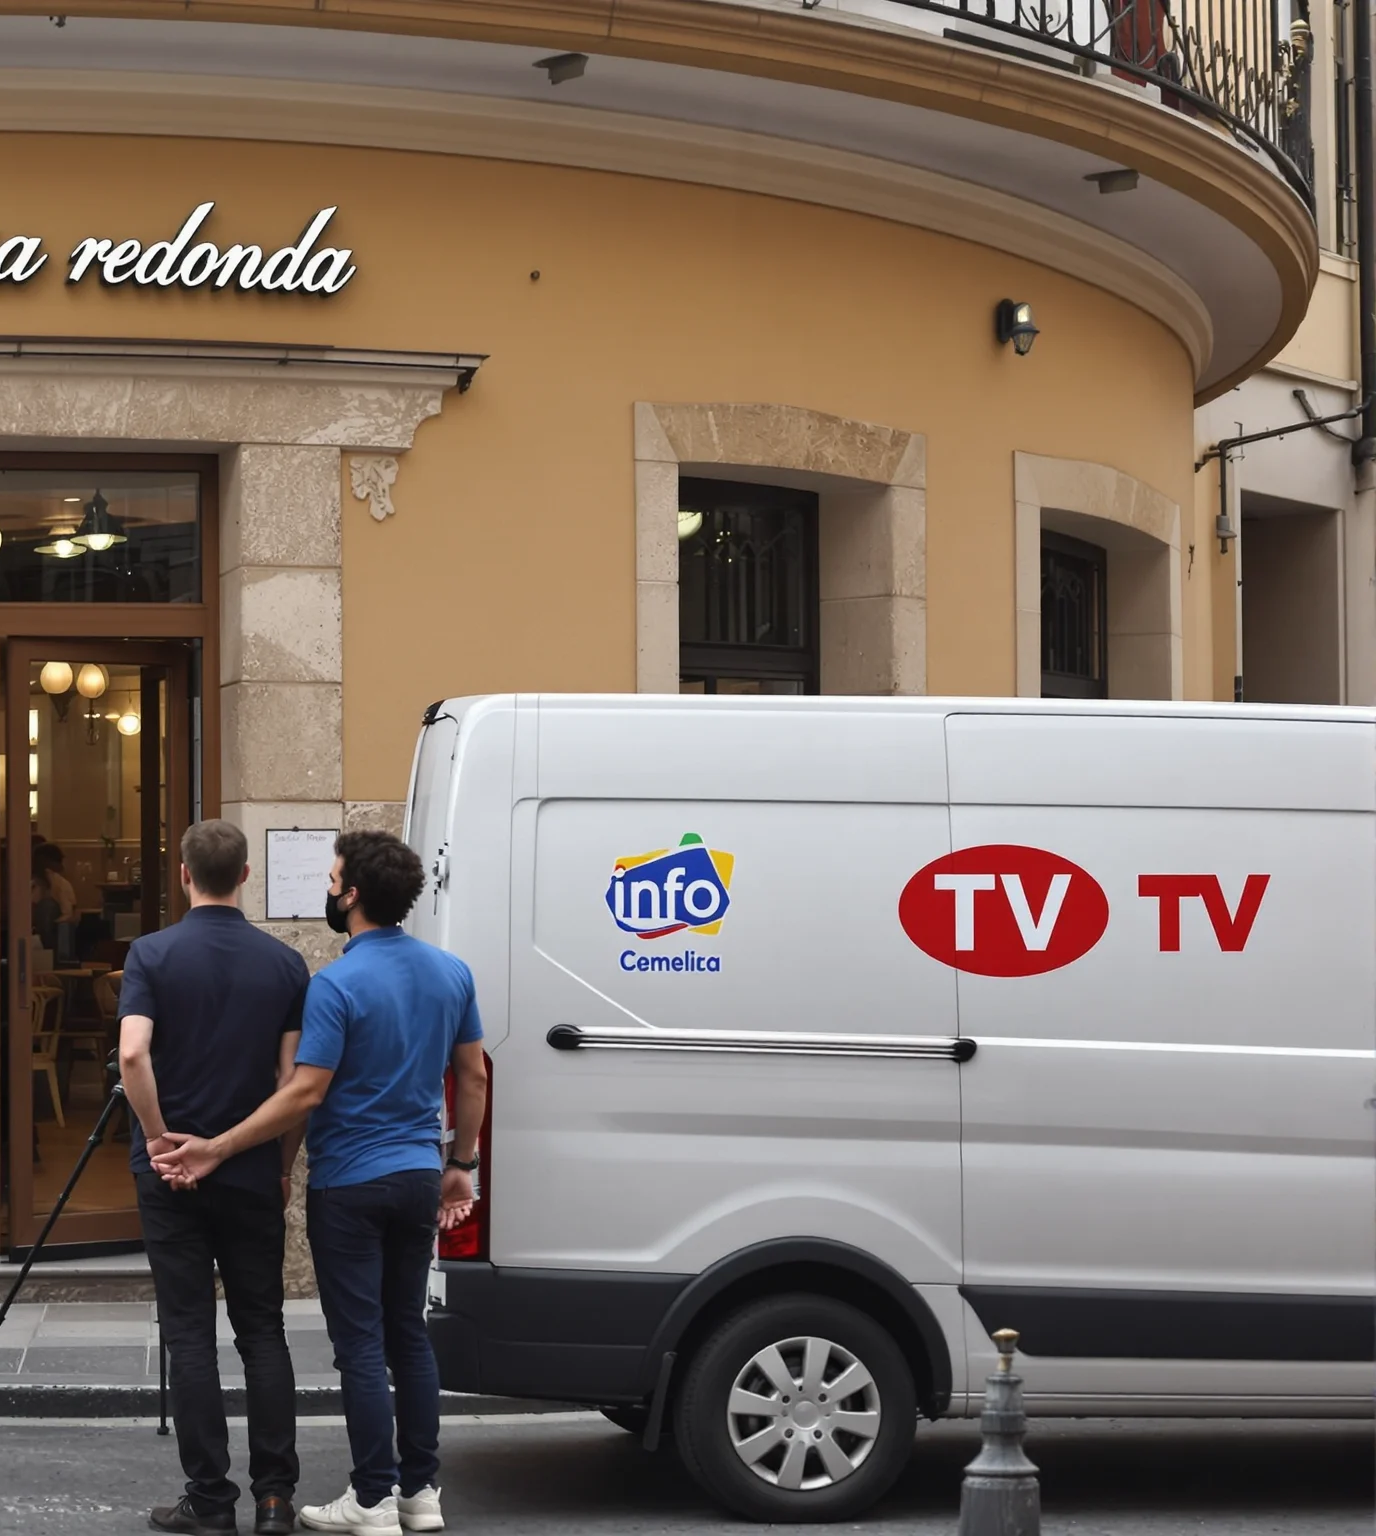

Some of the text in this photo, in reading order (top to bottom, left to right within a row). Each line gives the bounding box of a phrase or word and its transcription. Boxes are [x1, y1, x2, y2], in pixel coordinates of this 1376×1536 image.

[66, 201, 356, 294] redonda
[614, 867, 721, 919] info
[934, 873, 1271, 953] TV TV
